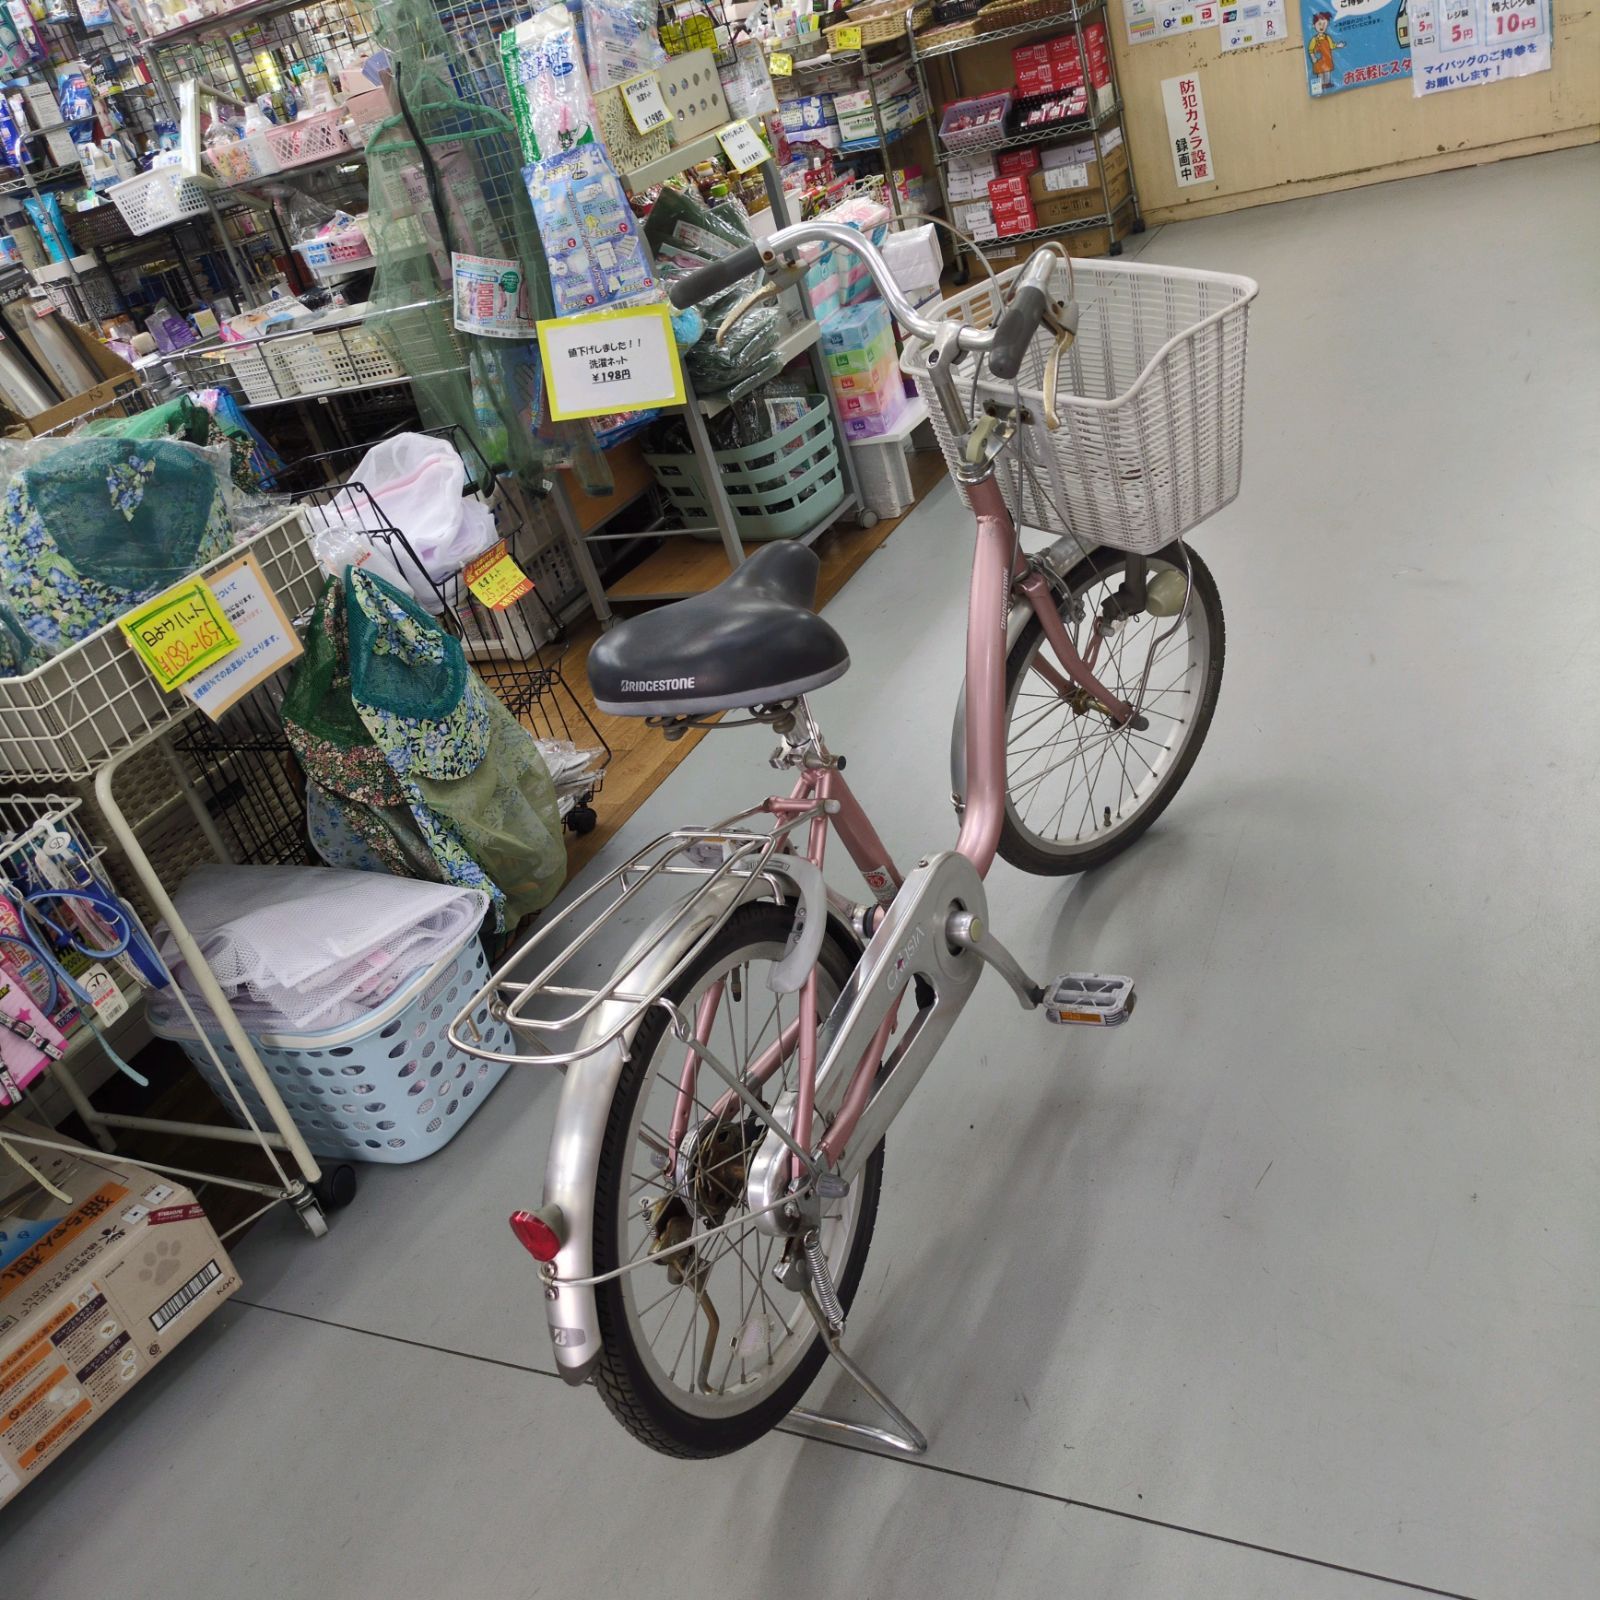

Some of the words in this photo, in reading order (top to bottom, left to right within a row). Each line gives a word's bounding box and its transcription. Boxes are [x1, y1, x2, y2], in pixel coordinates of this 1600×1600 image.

[1451, 24, 1473, 42] 5円
[1496, 13, 1536, 35] 10円
[1424, 43, 1537, 74] マイバッグのご持参を
[1180, 80, 1208, 179] 防犯カメラ設置
[1176, 138, 1192, 181] 録画中
[589, 356, 628, 369] 洗濯ネット
[592, 369, 631, 382] ¥198円
[621, 677, 695, 692] BRIDGESTONE
